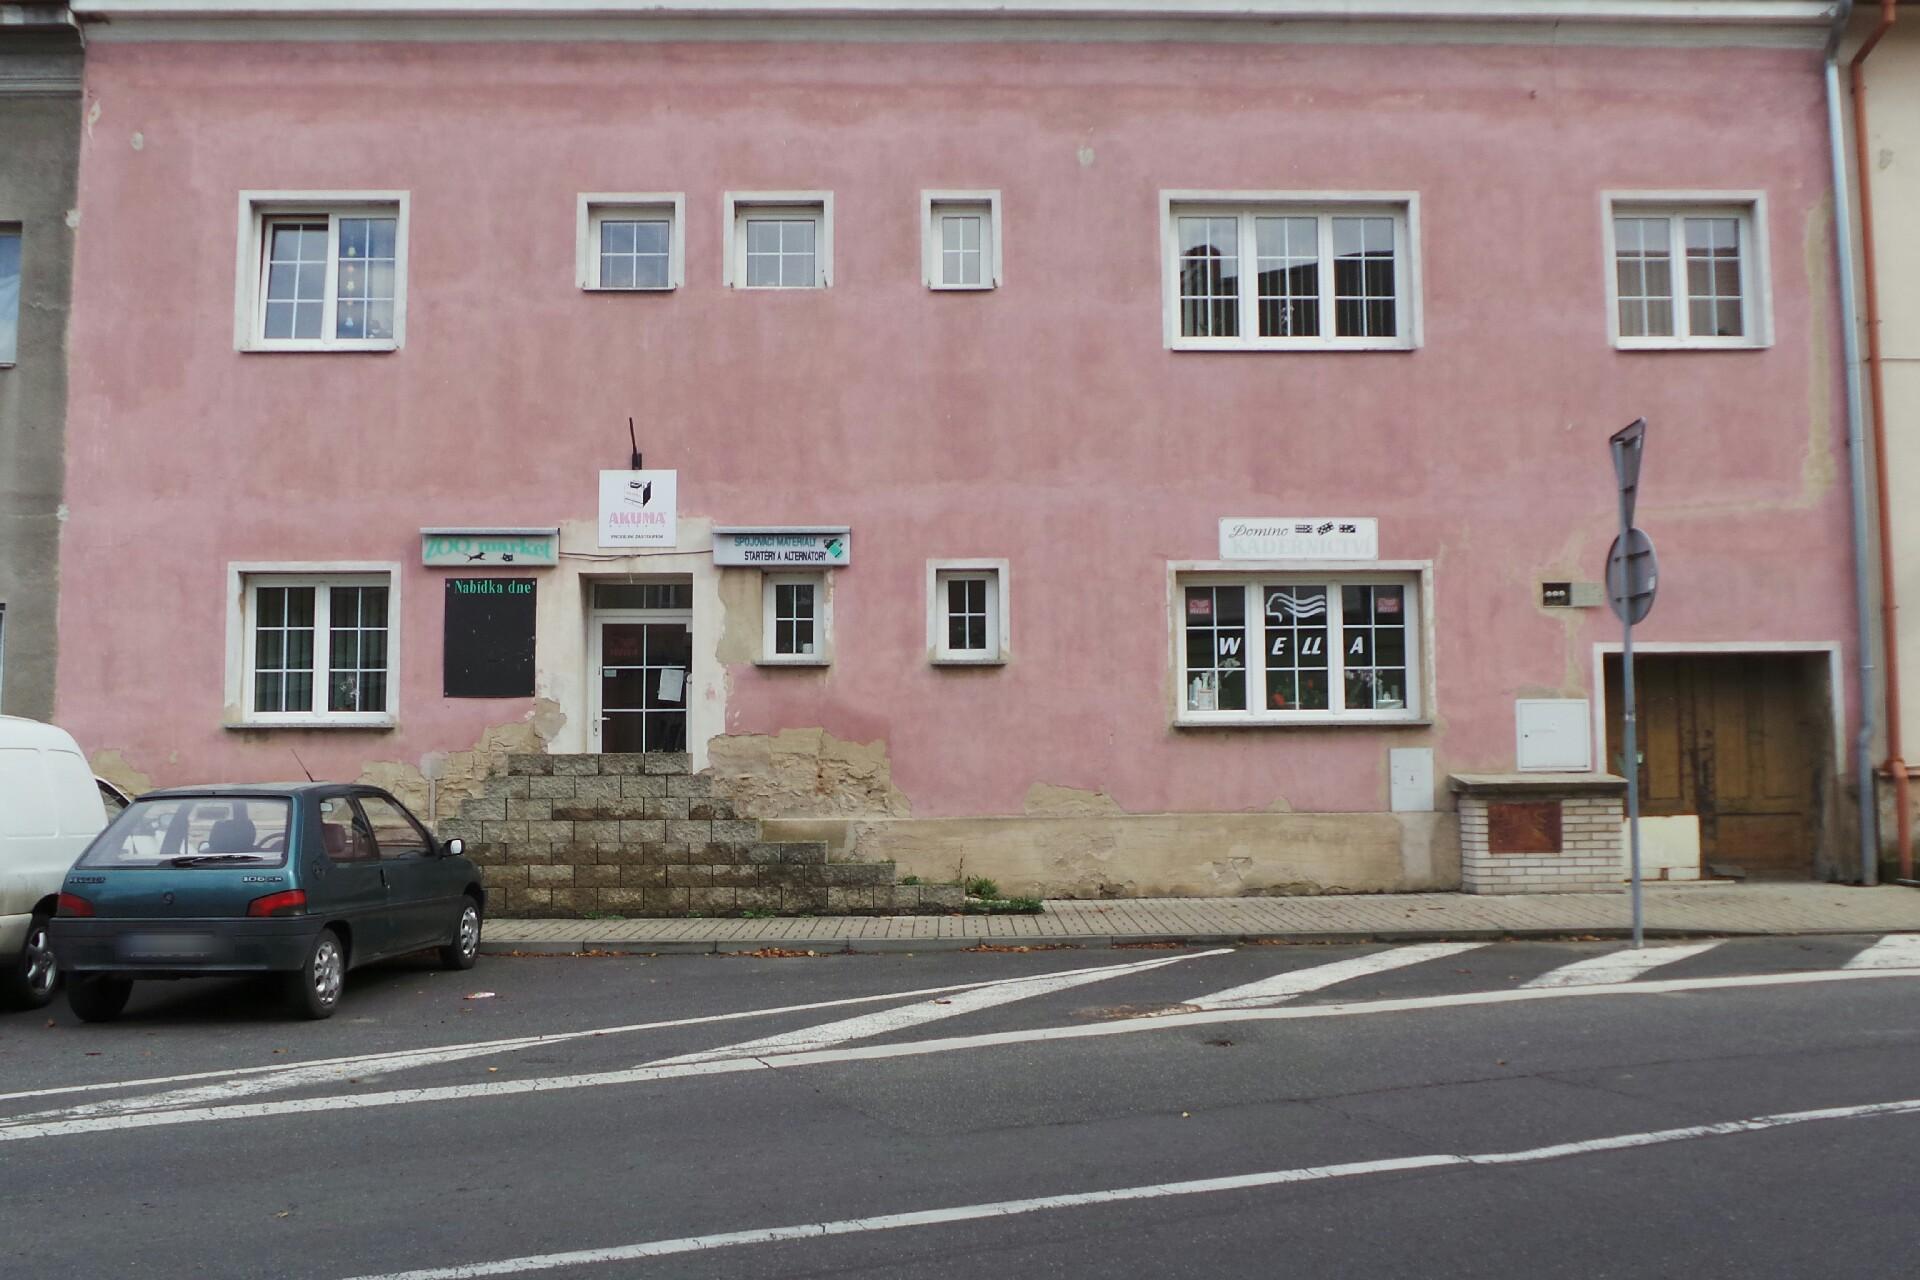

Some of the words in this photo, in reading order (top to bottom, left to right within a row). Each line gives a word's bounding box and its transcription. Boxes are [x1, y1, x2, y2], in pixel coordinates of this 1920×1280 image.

[609, 511, 665, 524] AKUMA
[1228, 524, 1288, 538] Domino
[479, 536, 551, 560] market
[777, 551, 782, 561] A
[454, 580, 503, 594] Nabídka
[508, 580, 531, 594] dne
